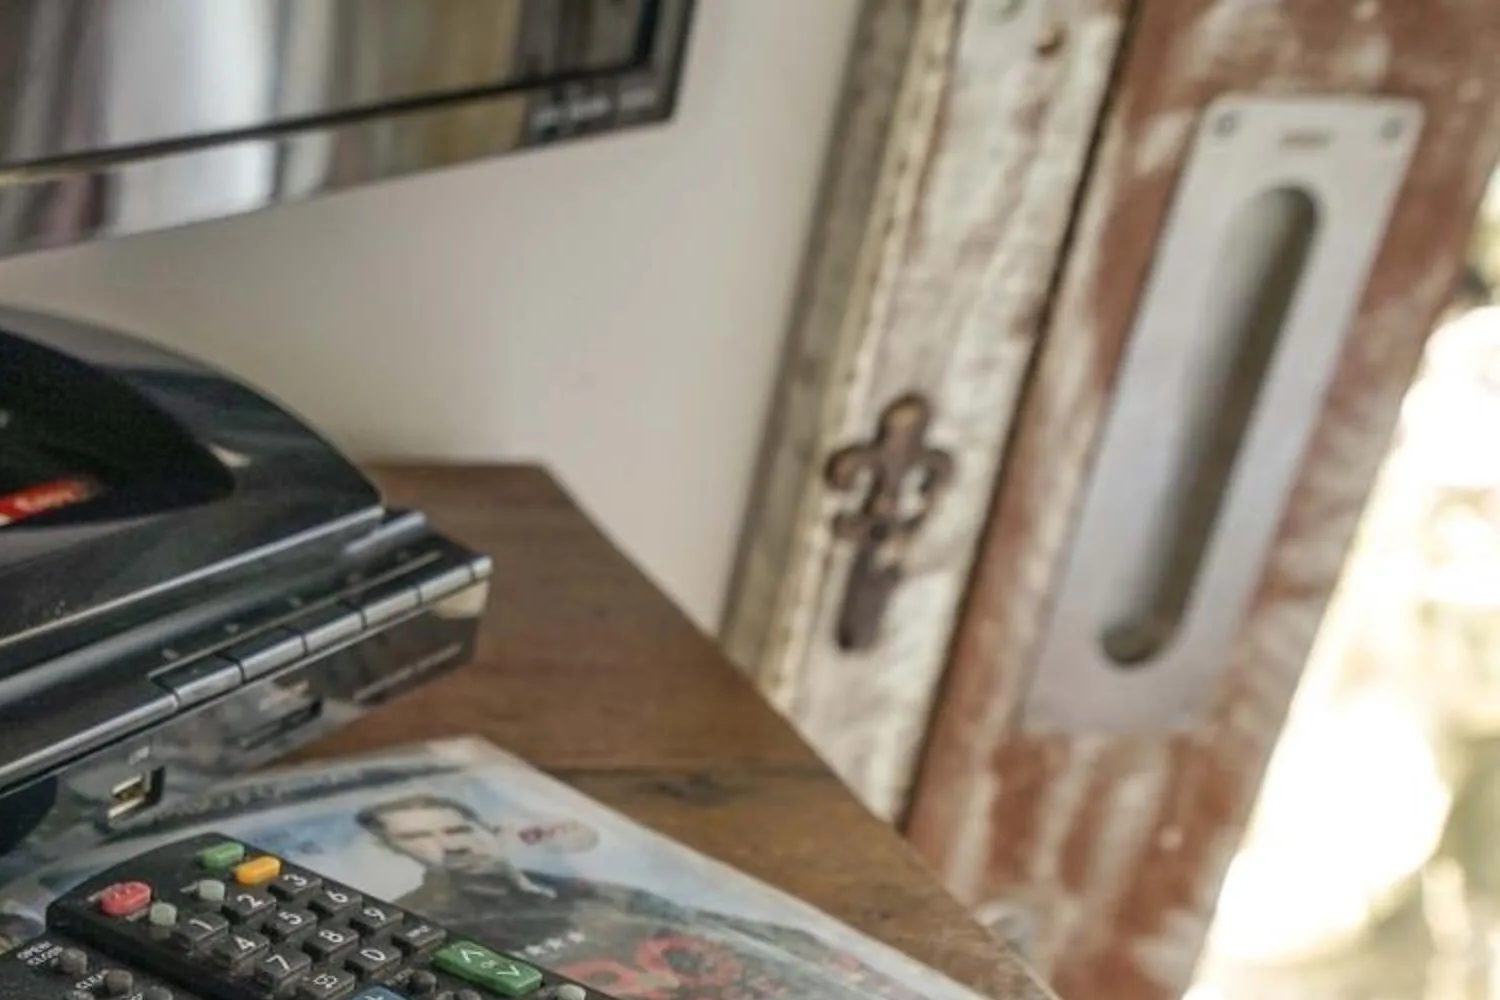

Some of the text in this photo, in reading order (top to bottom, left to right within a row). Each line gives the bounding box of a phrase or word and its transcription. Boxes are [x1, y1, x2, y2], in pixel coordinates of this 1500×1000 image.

[283, 873, 308, 887] 3
[237, 893, 264, 909] 2
[326, 889, 348, 904] 6
[278, 910, 304, 926] 5
[362, 905, 386, 922] 9
[188, 917, 214, 932] 1
[233, 935, 257, 951] 4
[318, 928, 345, 944] 8
[265, 953, 291, 972] 7
